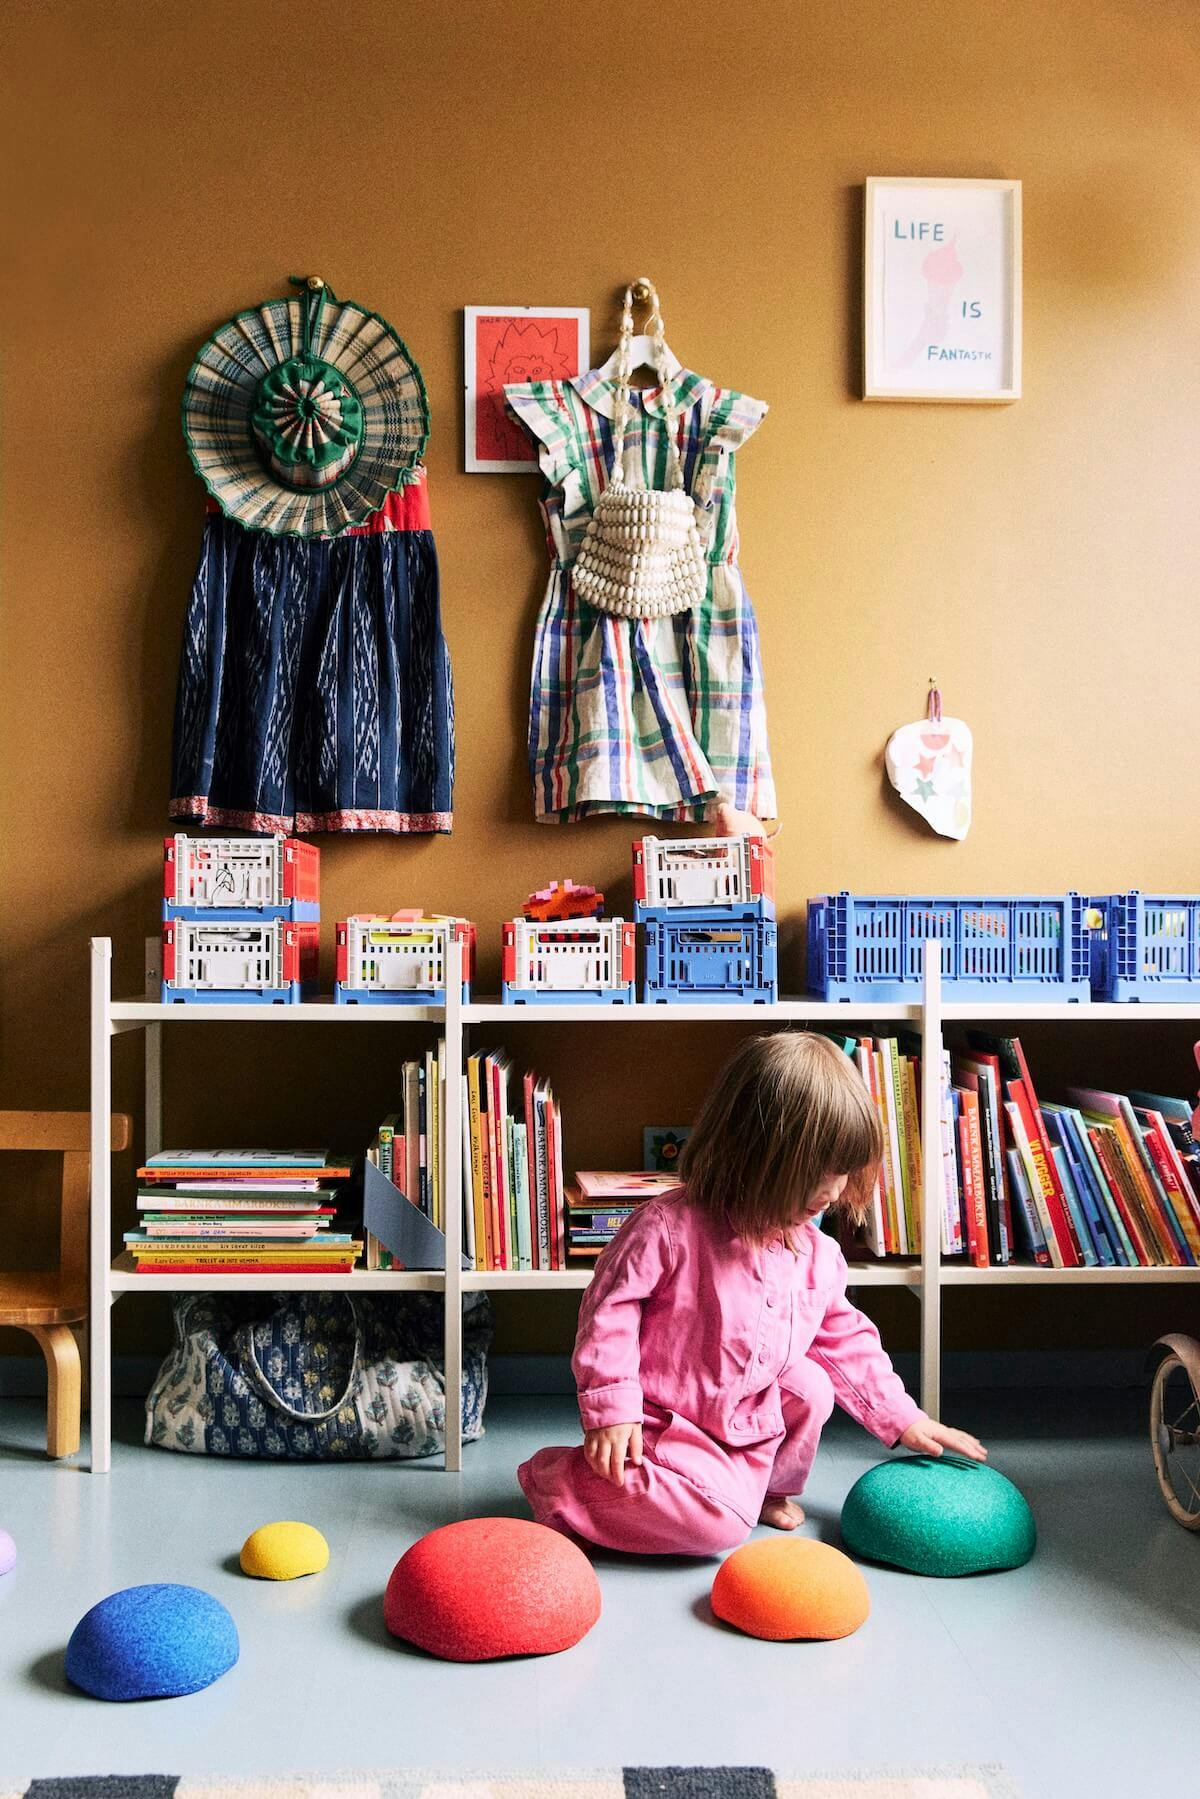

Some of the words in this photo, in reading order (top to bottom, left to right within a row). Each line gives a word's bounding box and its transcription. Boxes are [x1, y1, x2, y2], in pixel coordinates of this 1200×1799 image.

[894, 219, 944, 241] LIFE
[962, 301, 982, 318] IS
[1027, 1138, 1042, 1153] VI
[967, 1107, 985, 1227] BARNKAMMARBOKEN
[1031, 1151, 1056, 1198] BYGGER
[537, 1129, 548, 1249] BARNKAMMARBOKEN
[175, 1199, 296, 1209] BARNKAMMARBOKEN
